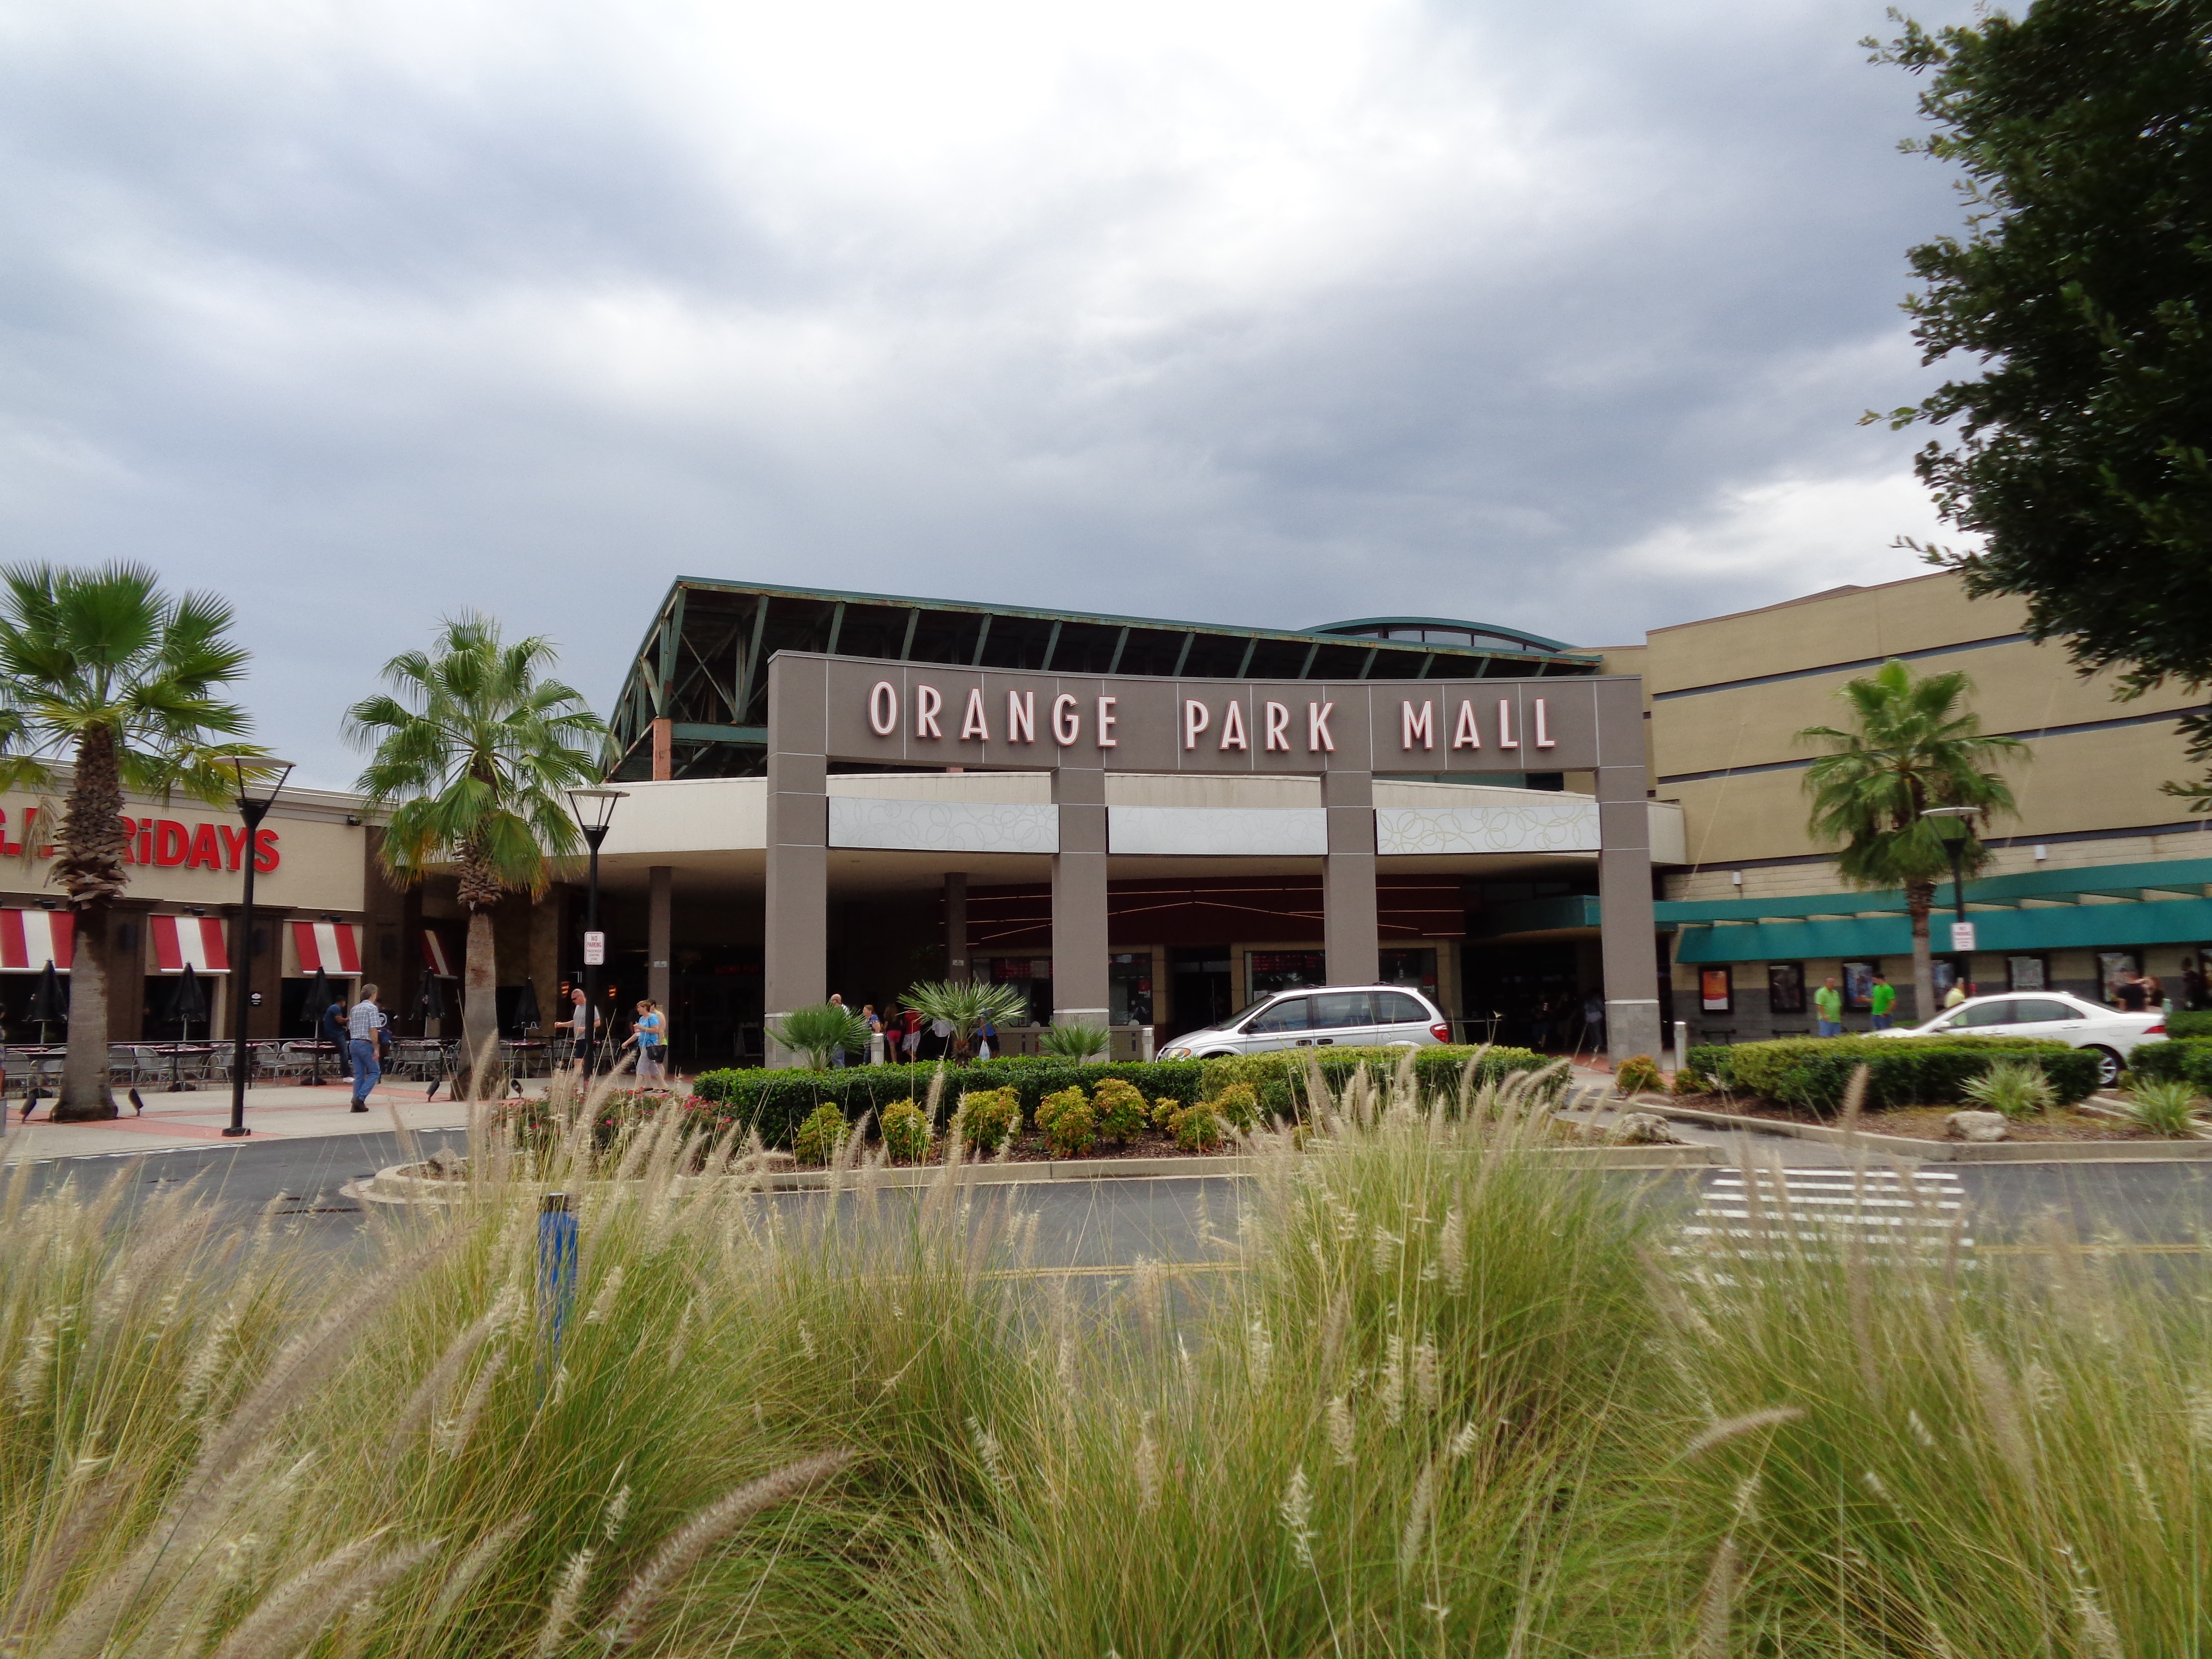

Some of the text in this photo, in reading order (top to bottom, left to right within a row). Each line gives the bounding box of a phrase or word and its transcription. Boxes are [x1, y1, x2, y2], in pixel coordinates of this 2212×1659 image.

[869, 680, 1556, 751] ORANGE PARK MALL
[117, 815, 280, 873] RiDAYS
